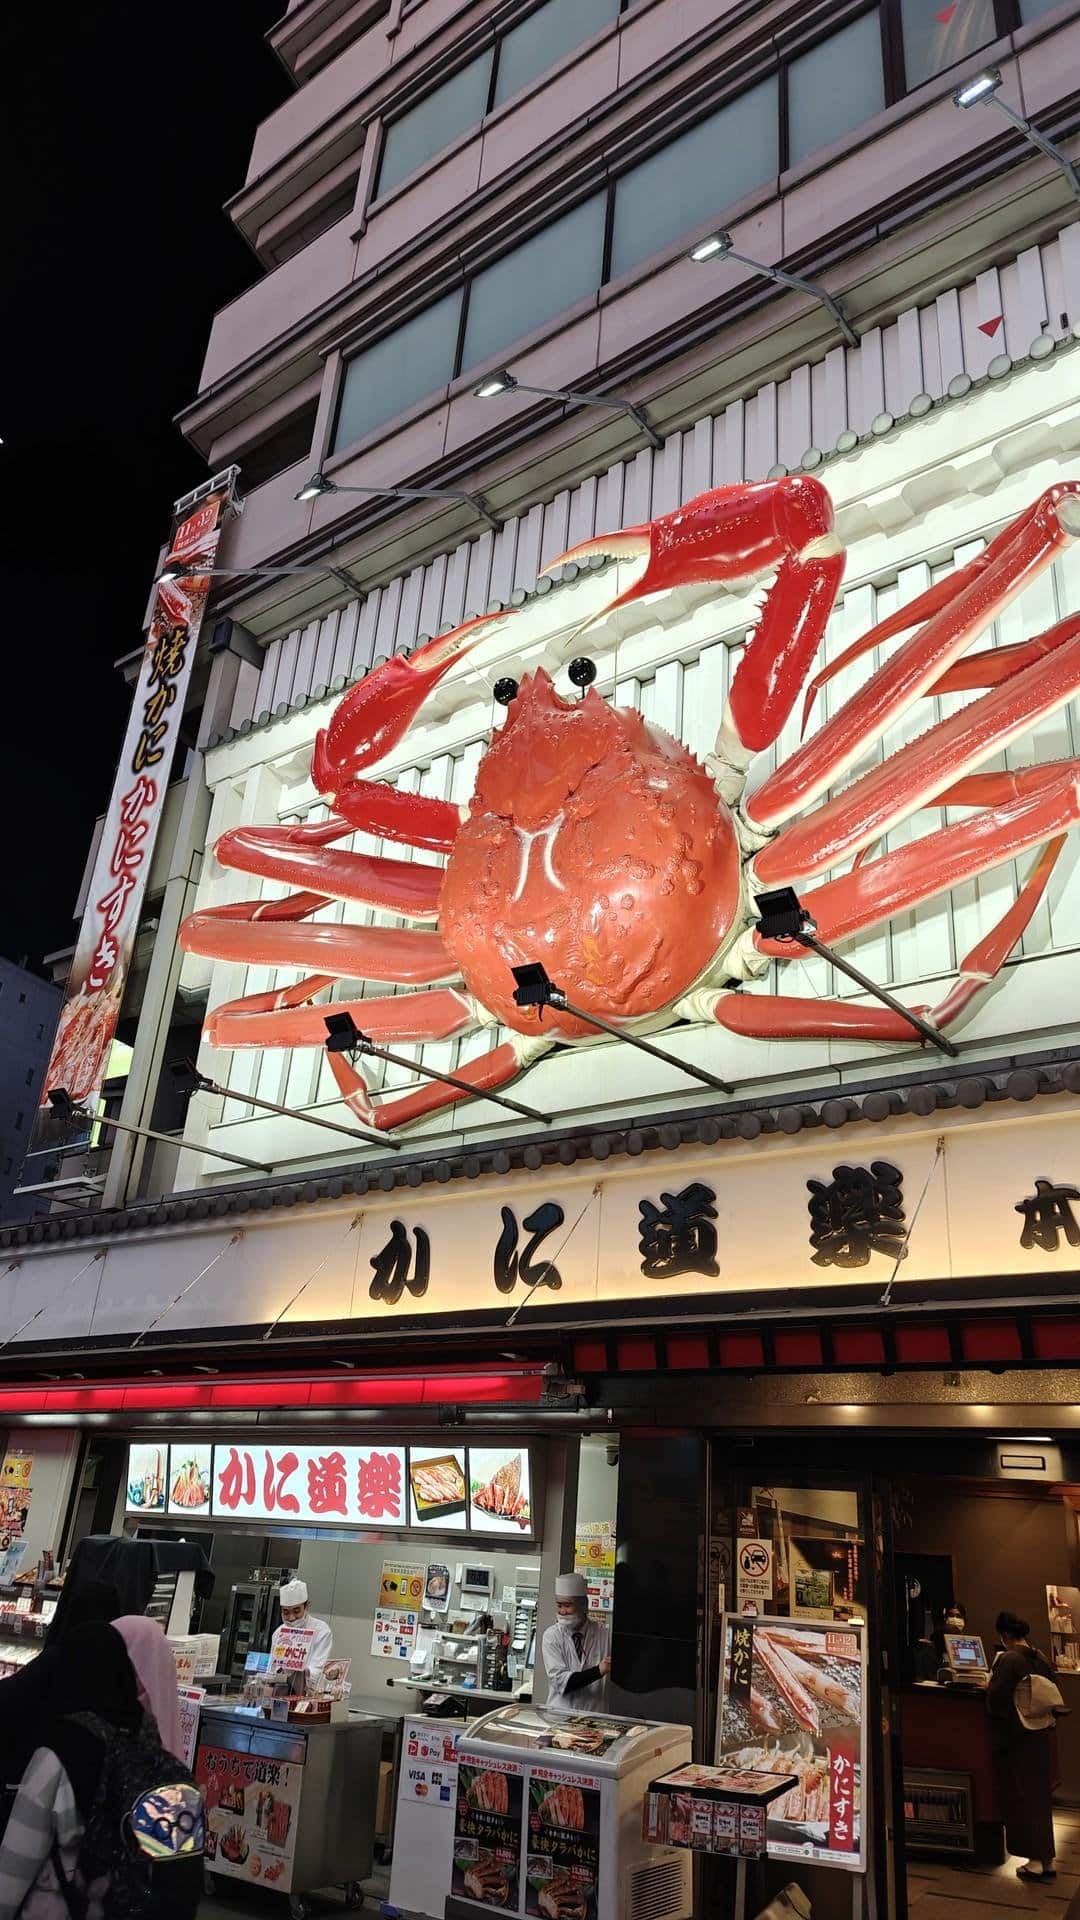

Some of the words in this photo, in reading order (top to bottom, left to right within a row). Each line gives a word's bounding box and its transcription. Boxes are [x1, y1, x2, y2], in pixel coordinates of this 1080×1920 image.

[131, 630, 188, 773] 焼かに
[88, 777, 155, 990] かにすき
[734, 1629, 751, 1684] 焼かに
[408, 1768, 426, 1781] VISA
[832, 1753, 851, 1842] かにすき
